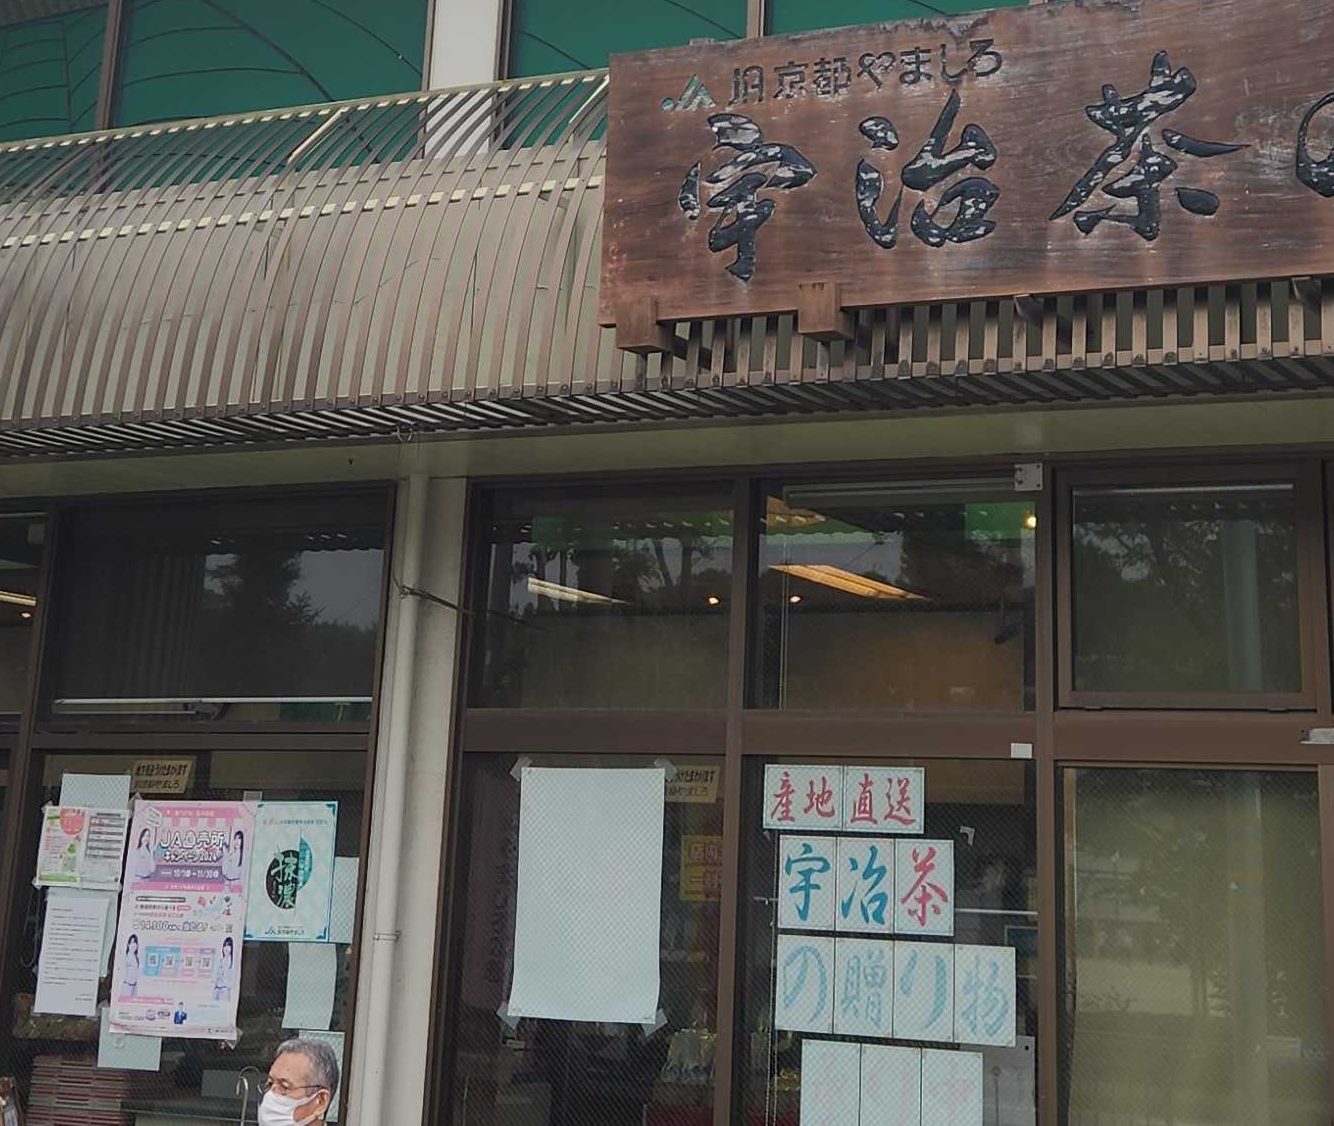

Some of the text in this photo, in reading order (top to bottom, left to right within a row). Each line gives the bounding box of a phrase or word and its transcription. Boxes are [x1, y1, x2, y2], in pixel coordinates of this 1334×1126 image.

[770, 771, 917, 826] 産地直送
[784, 842, 949, 927] 宇治茶
[782, 945, 1010, 1037] の贈り物
